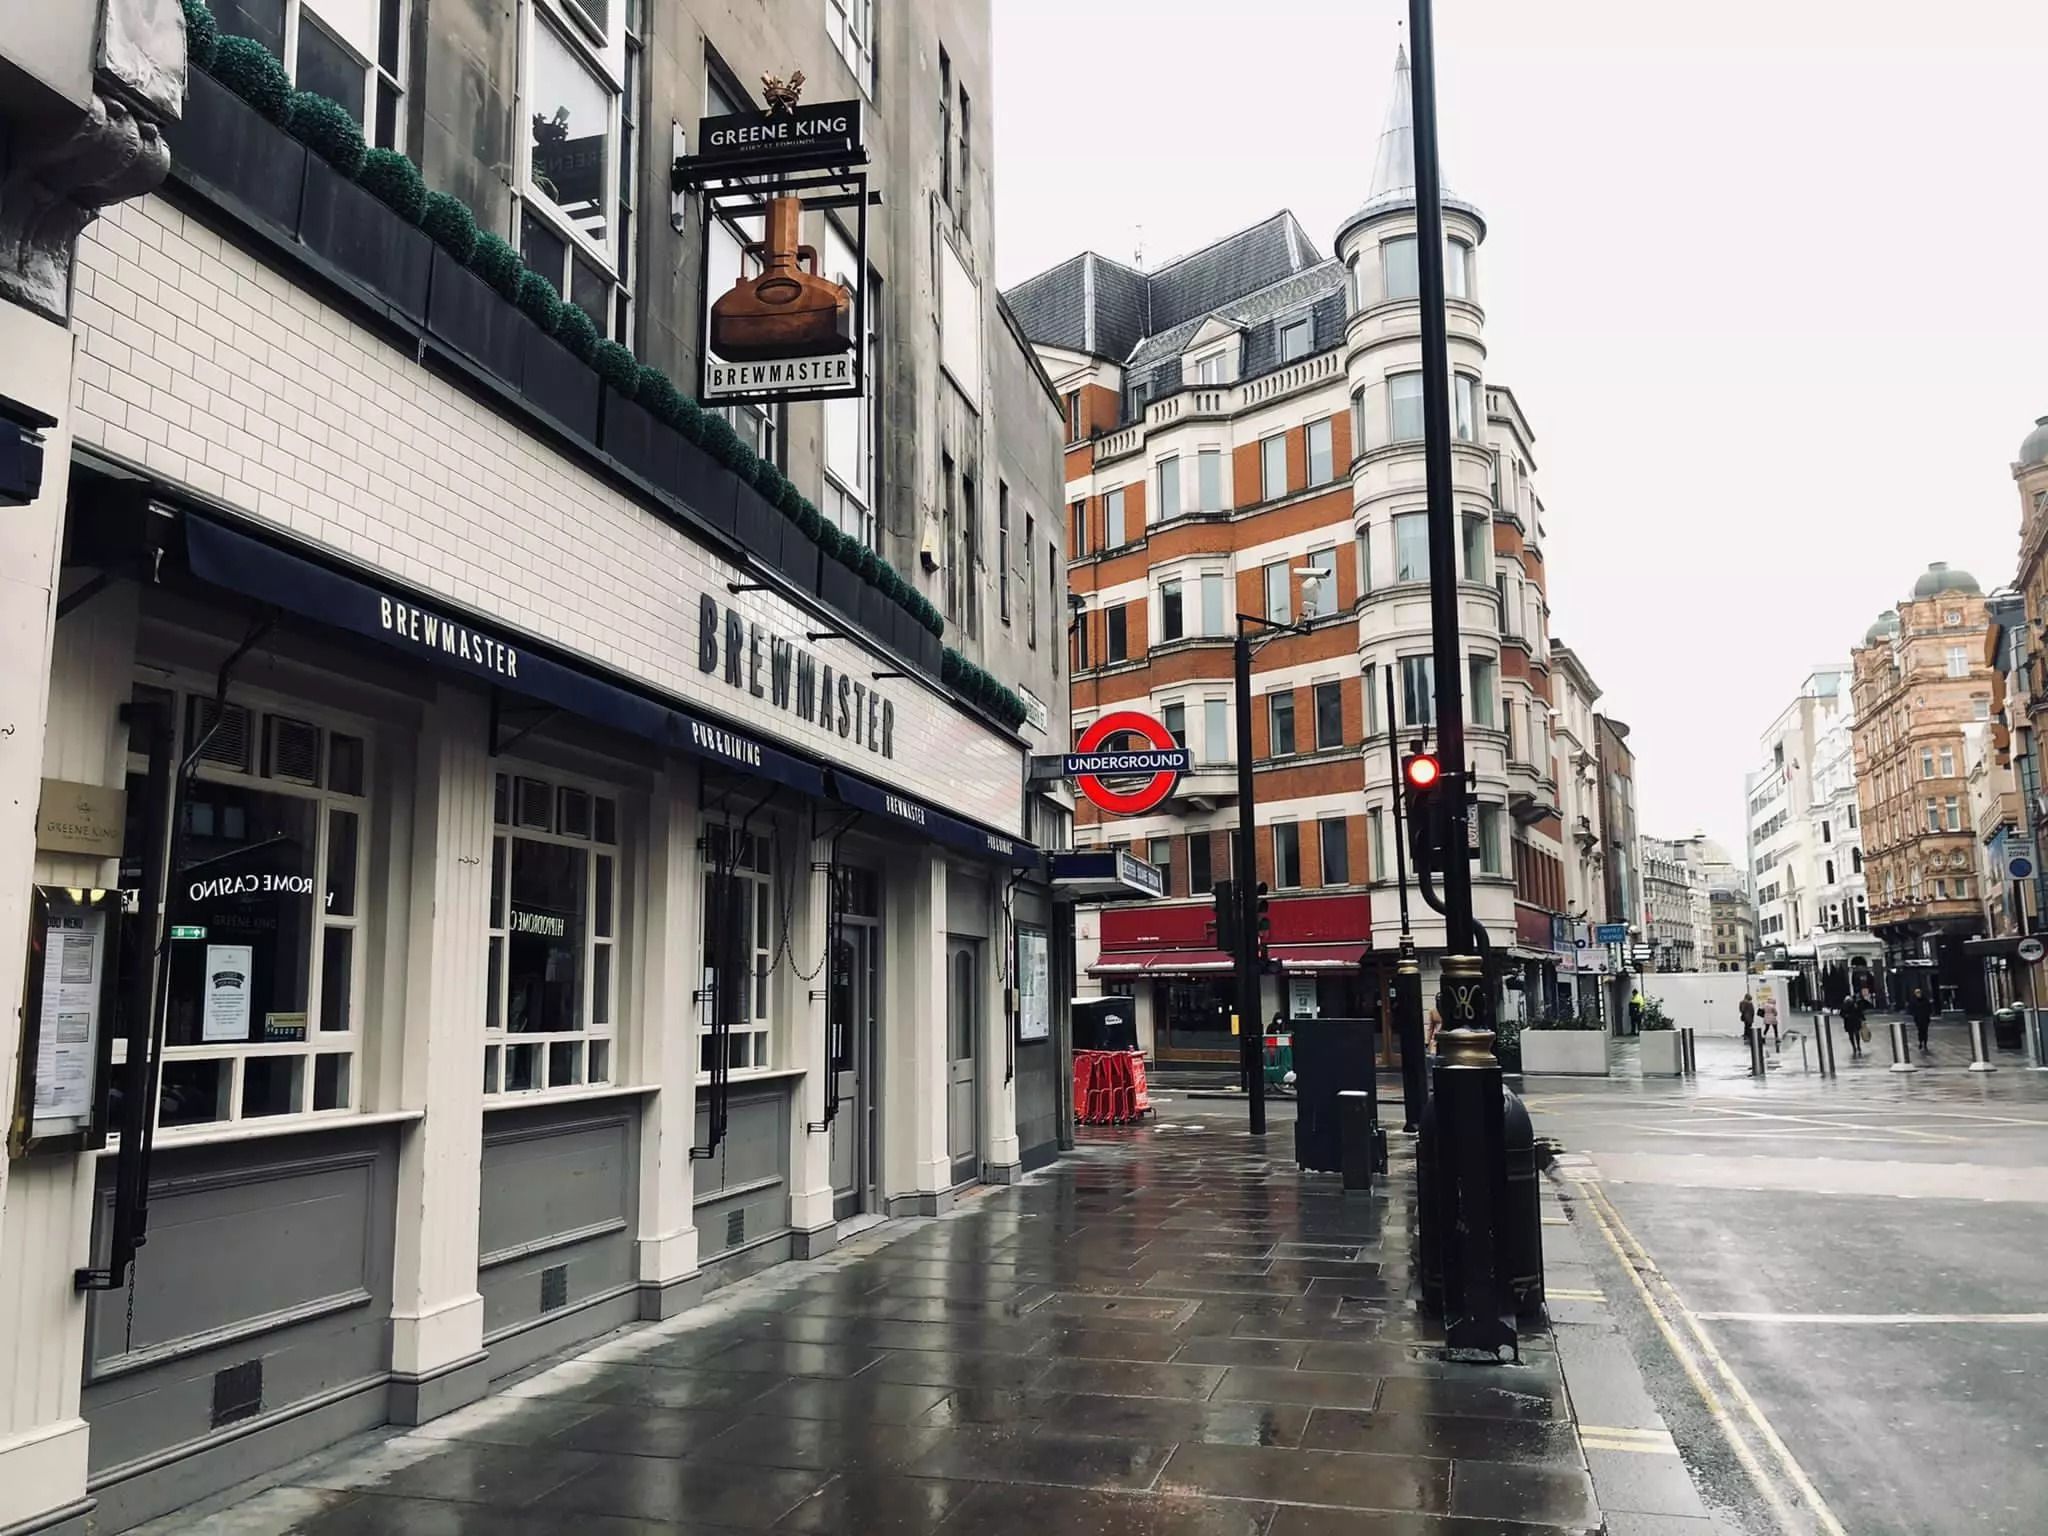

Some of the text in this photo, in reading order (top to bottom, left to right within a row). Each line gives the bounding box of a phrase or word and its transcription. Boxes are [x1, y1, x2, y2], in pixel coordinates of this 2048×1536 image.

[710, 117, 847, 146] GREENE KING
[713, 360, 847, 387] BREWMASTER
[379, 597, 519, 679] BREWMASTER
[700, 592, 895, 760] BREWMASTER
[1068, 754, 1184, 771] UNDERGROUND
[47, 822, 89, 836] GREENE
